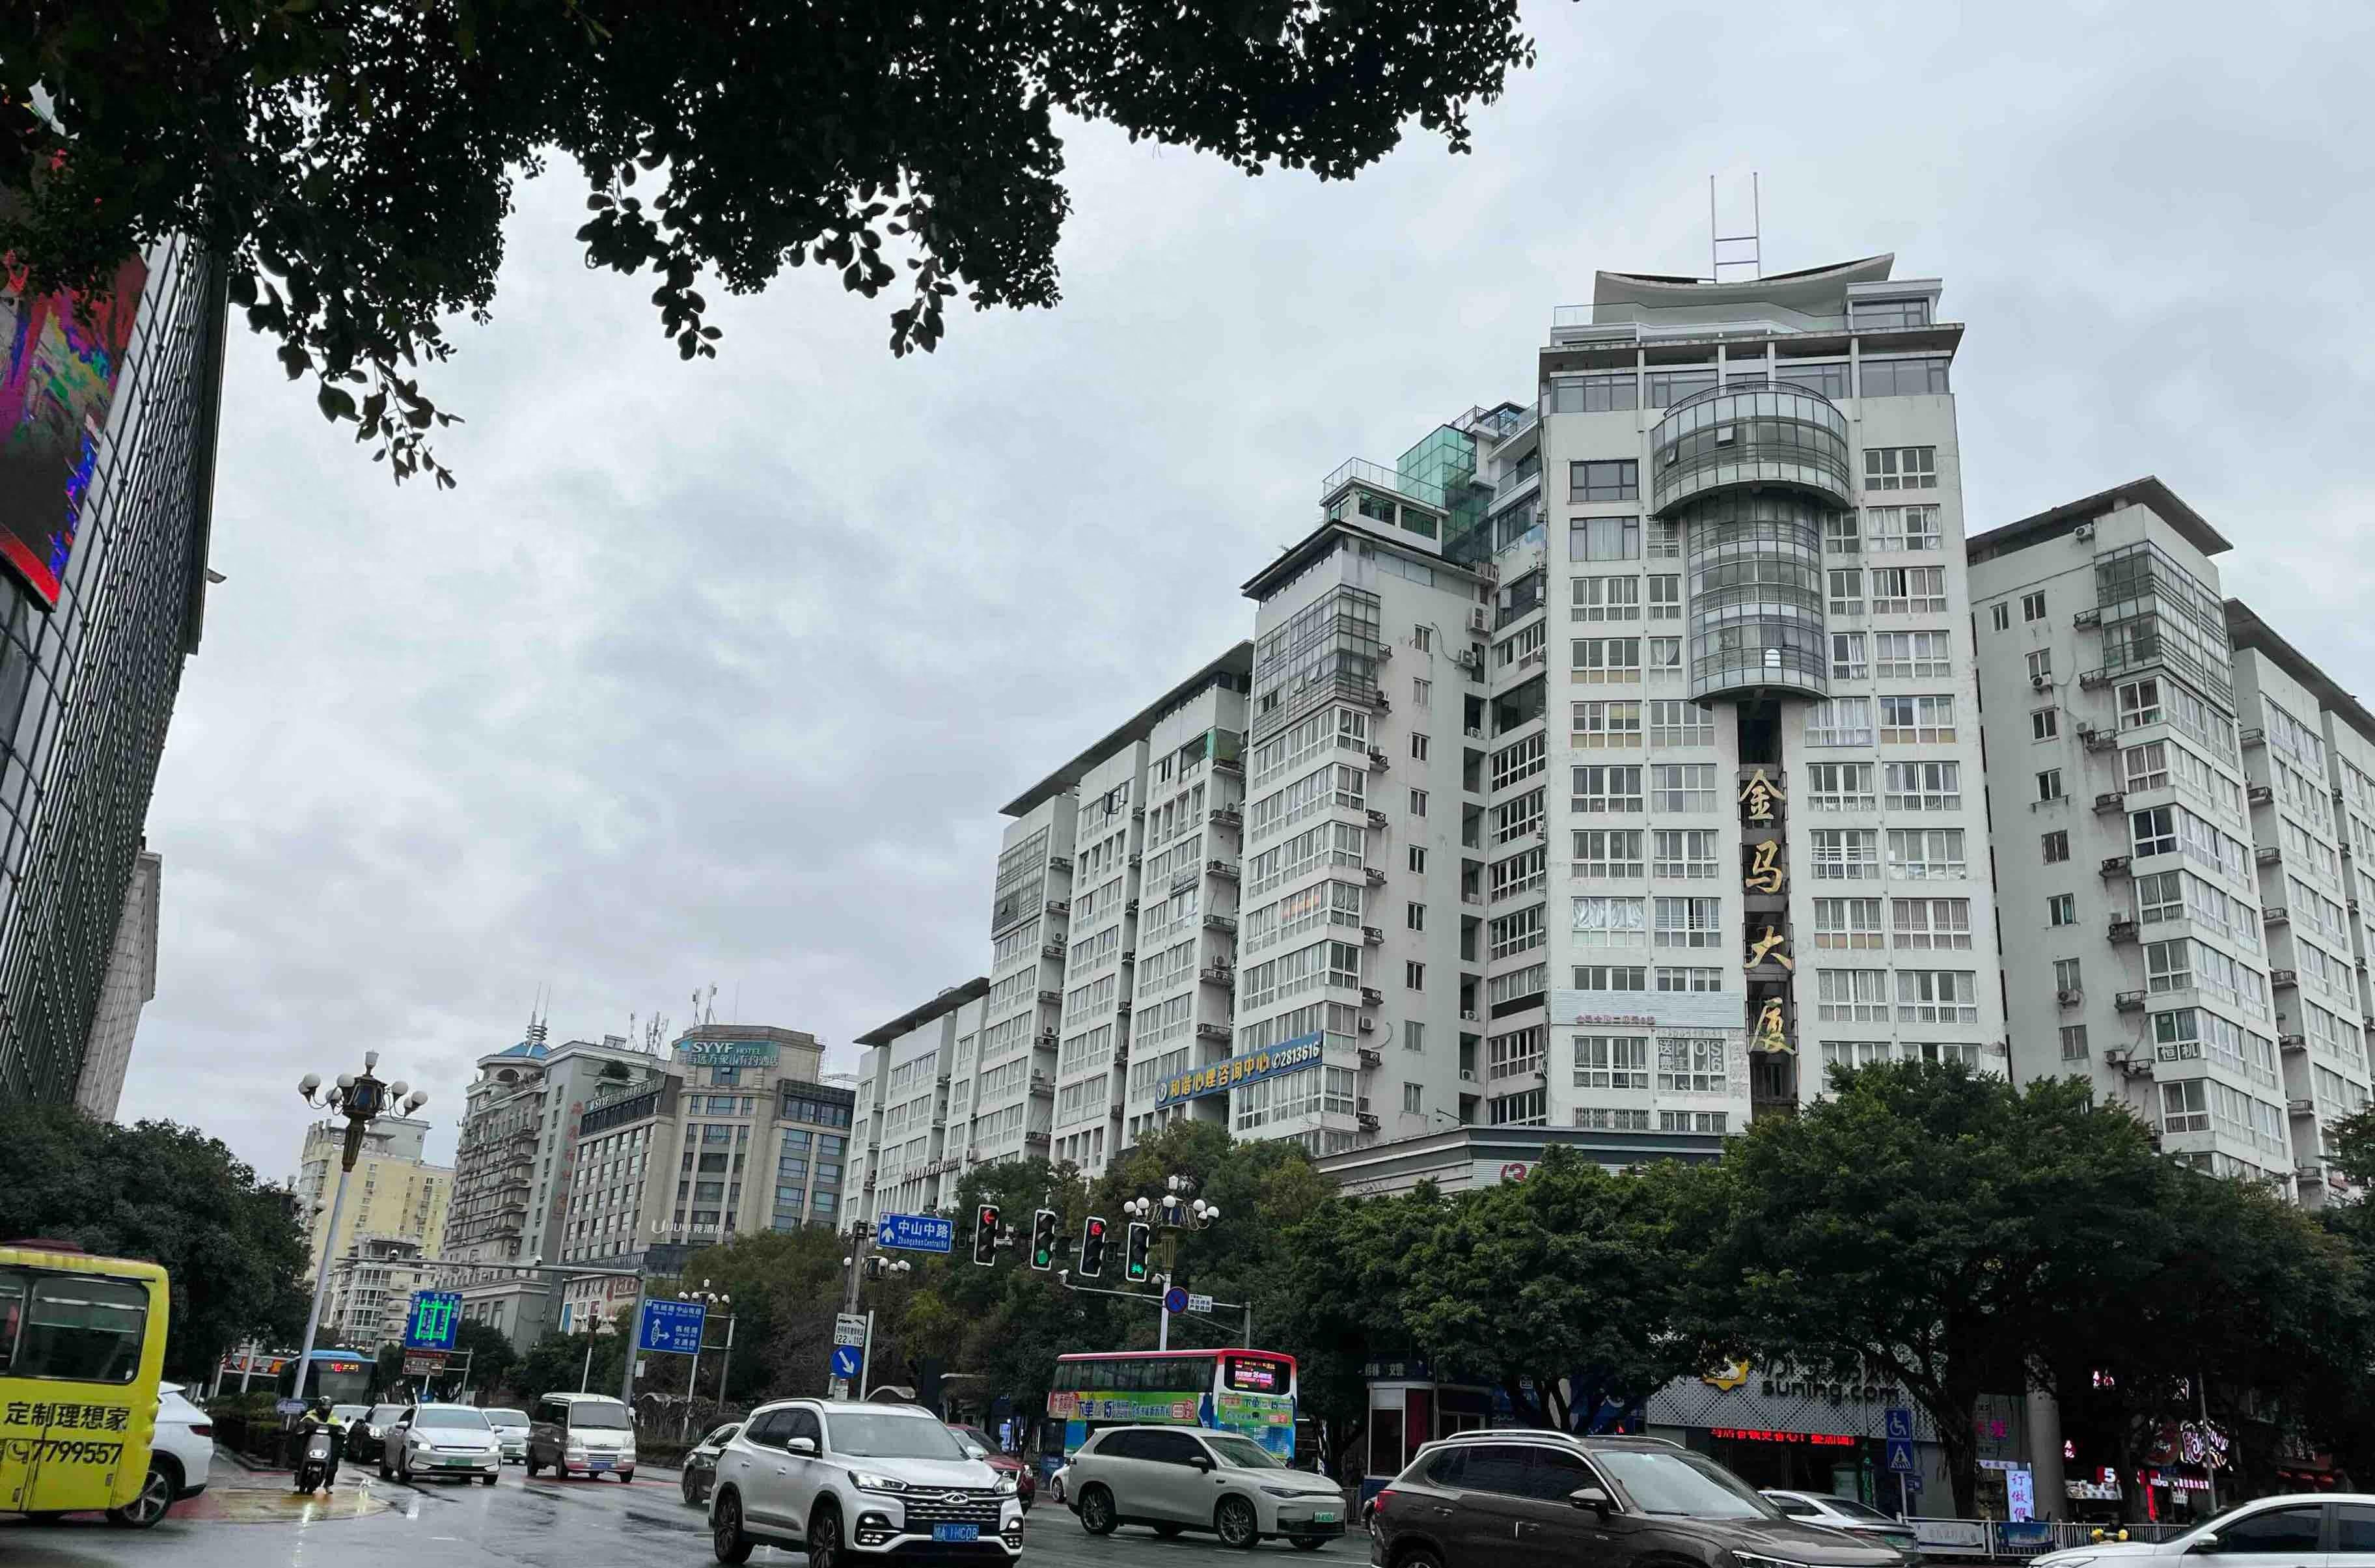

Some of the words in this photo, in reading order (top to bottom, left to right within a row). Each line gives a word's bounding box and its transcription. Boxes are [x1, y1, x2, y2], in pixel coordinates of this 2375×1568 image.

[1738, 769, 1798, 1054] 金马大厦
[693, 1041, 734, 1053] SYYF
[1170, 1053, 1270, 1098] 和谐心理咨询中心
[898, 1219, 948, 1238] 中山中路
[4, 1401, 130, 1433] 定制理想家
[32, 1440, 124, 1465] 7799557
